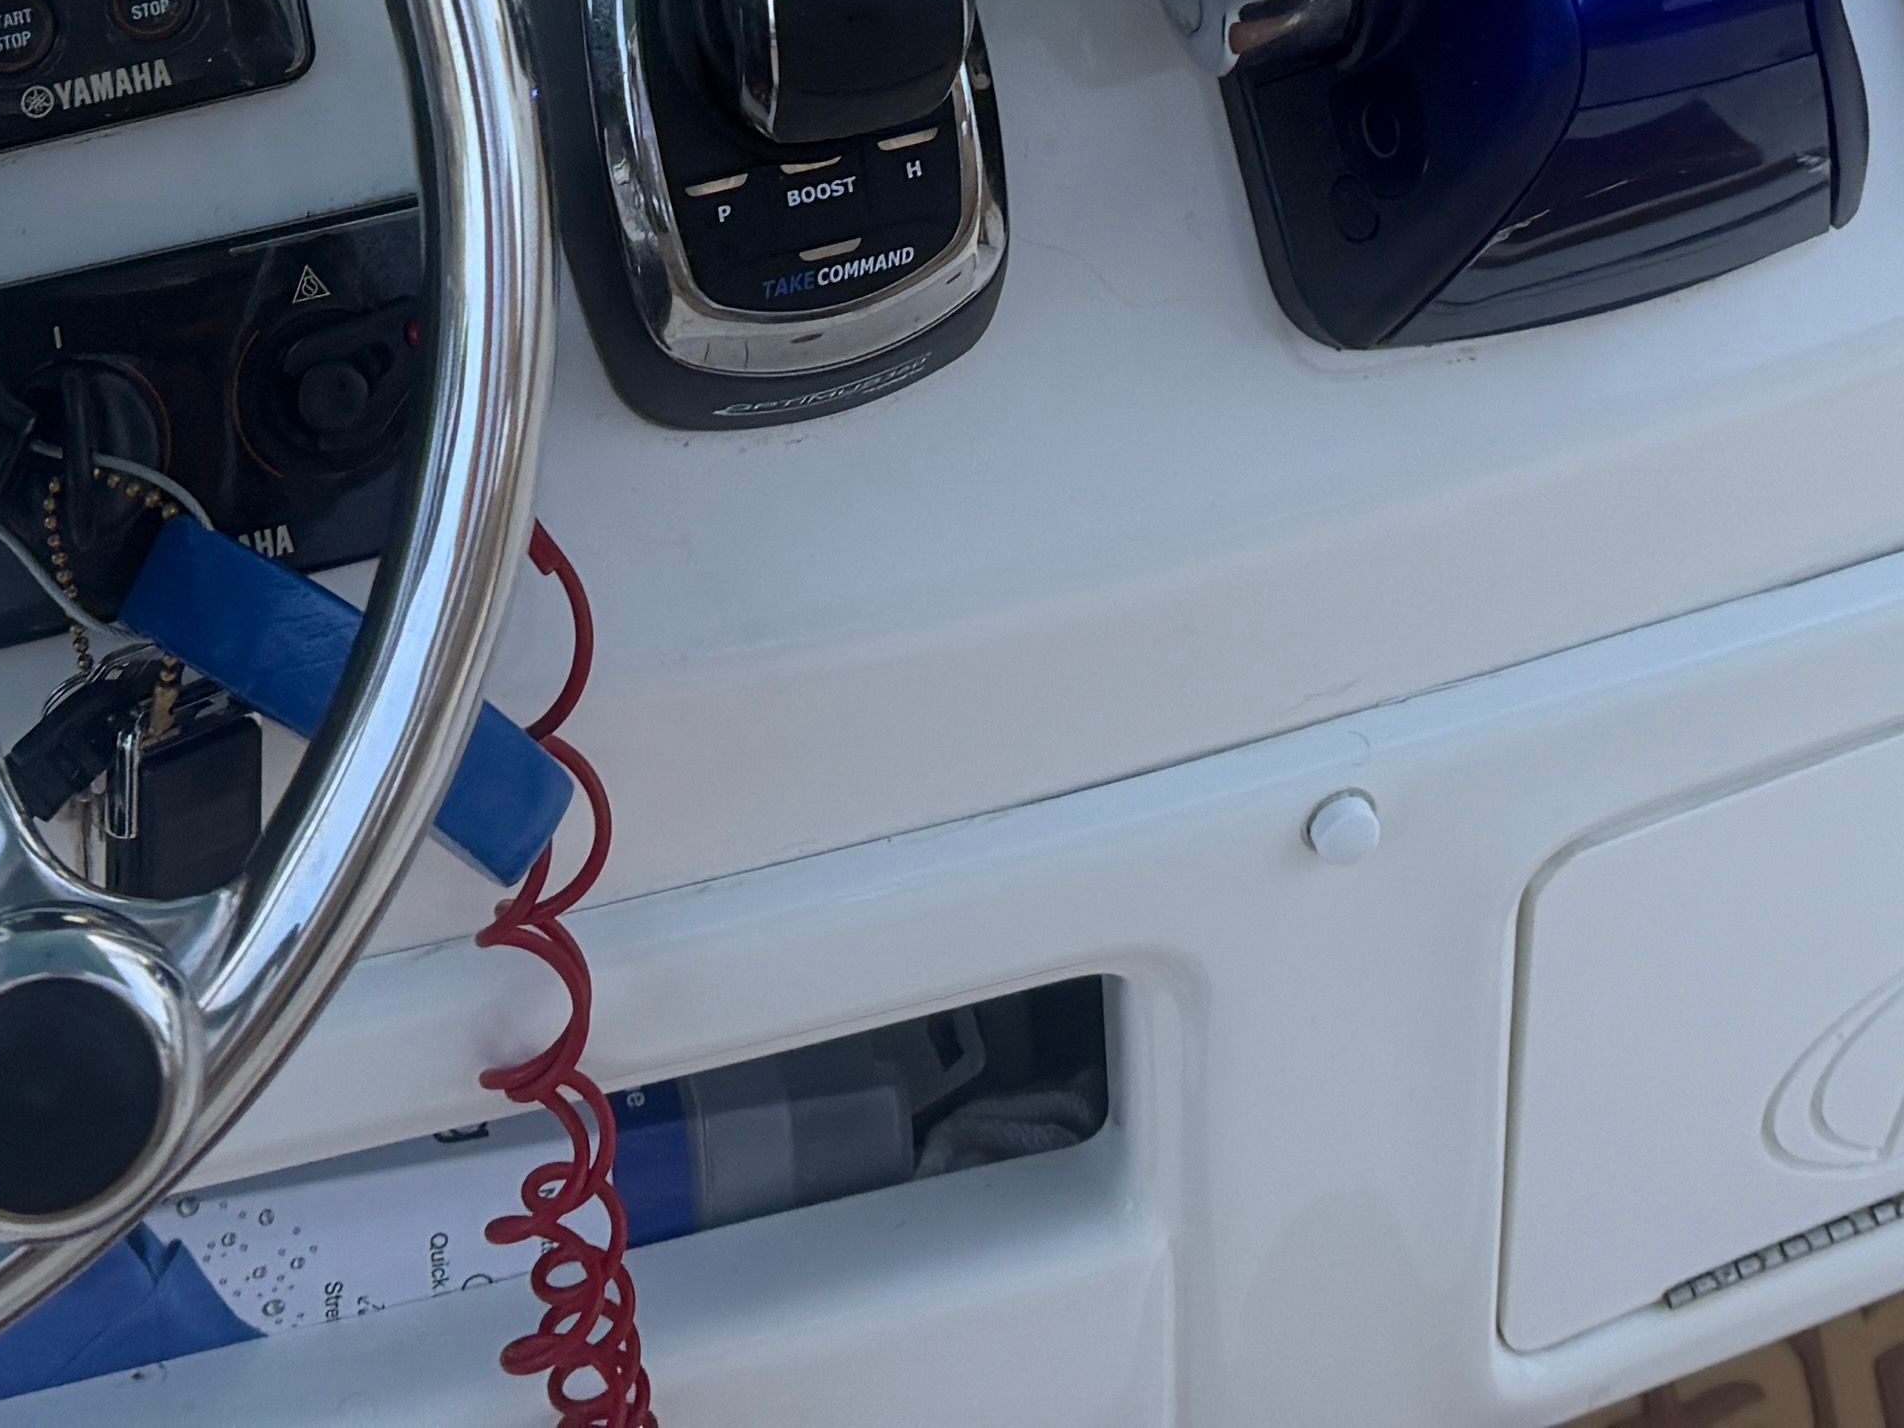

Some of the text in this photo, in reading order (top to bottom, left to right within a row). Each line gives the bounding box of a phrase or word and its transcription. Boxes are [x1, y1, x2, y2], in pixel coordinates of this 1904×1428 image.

[53, 58, 173, 110] YAMAHA
[906, 161, 924, 180] H
[786, 176, 857, 208] BOOST
[717, 206, 732, 224] P
[430, 1231, 449, 1291] Quick
